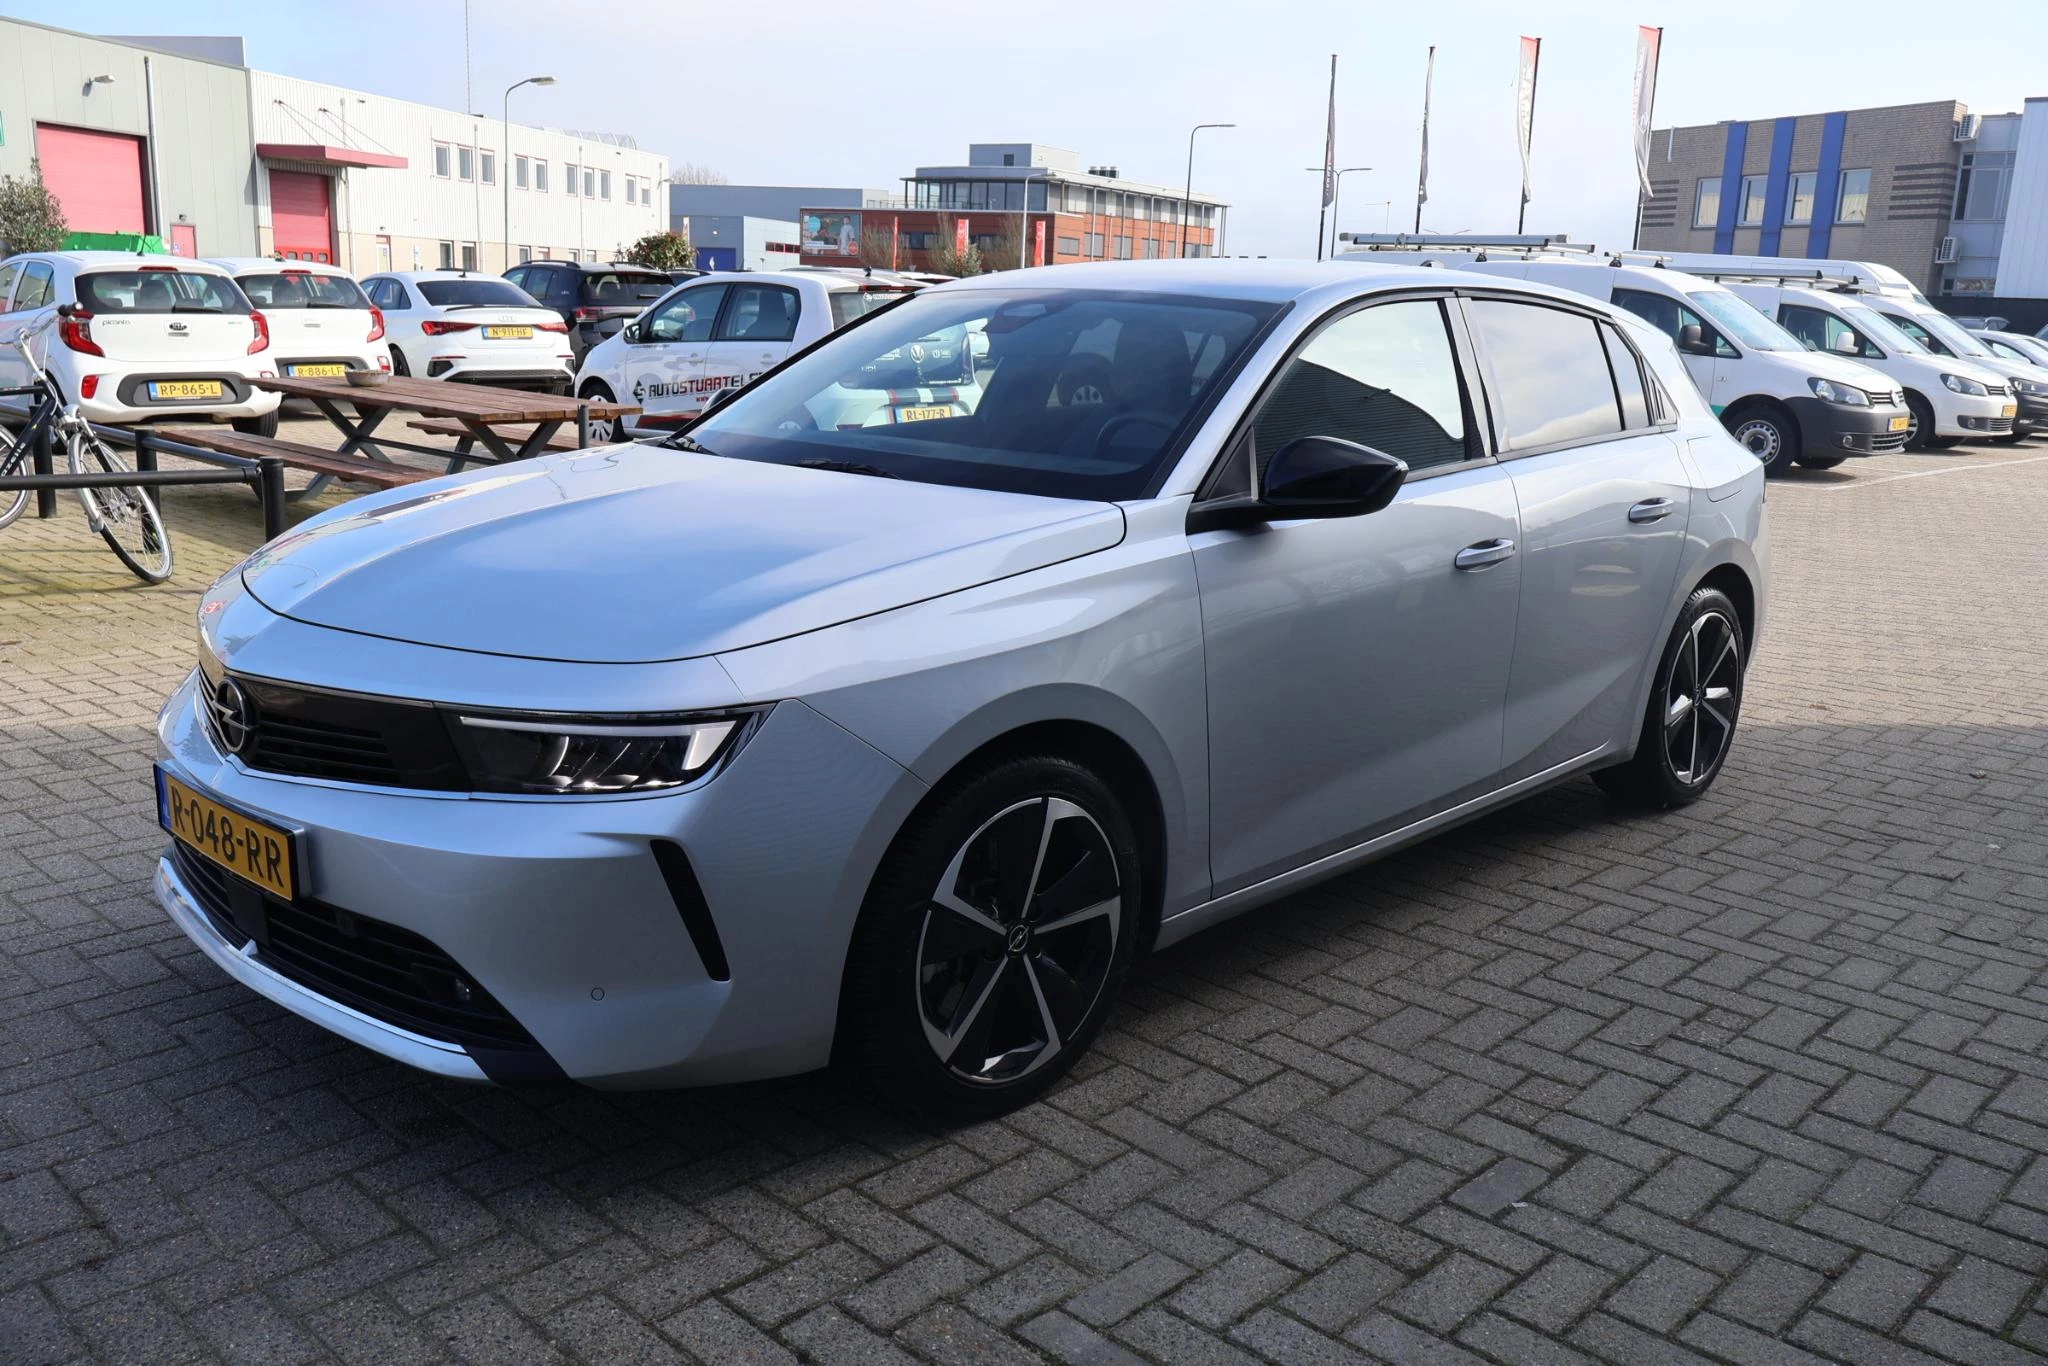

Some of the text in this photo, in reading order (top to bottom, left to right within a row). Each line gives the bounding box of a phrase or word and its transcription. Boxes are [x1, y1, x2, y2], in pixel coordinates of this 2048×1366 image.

[492, 327, 529, 337] N-911-HF
[297, 366, 342, 376] R-886-LF
[160, 383, 219, 396] RP-865-L
[906, 408, 945, 421] RL-177-R
[171, 785, 284, 888] R-048-RR
